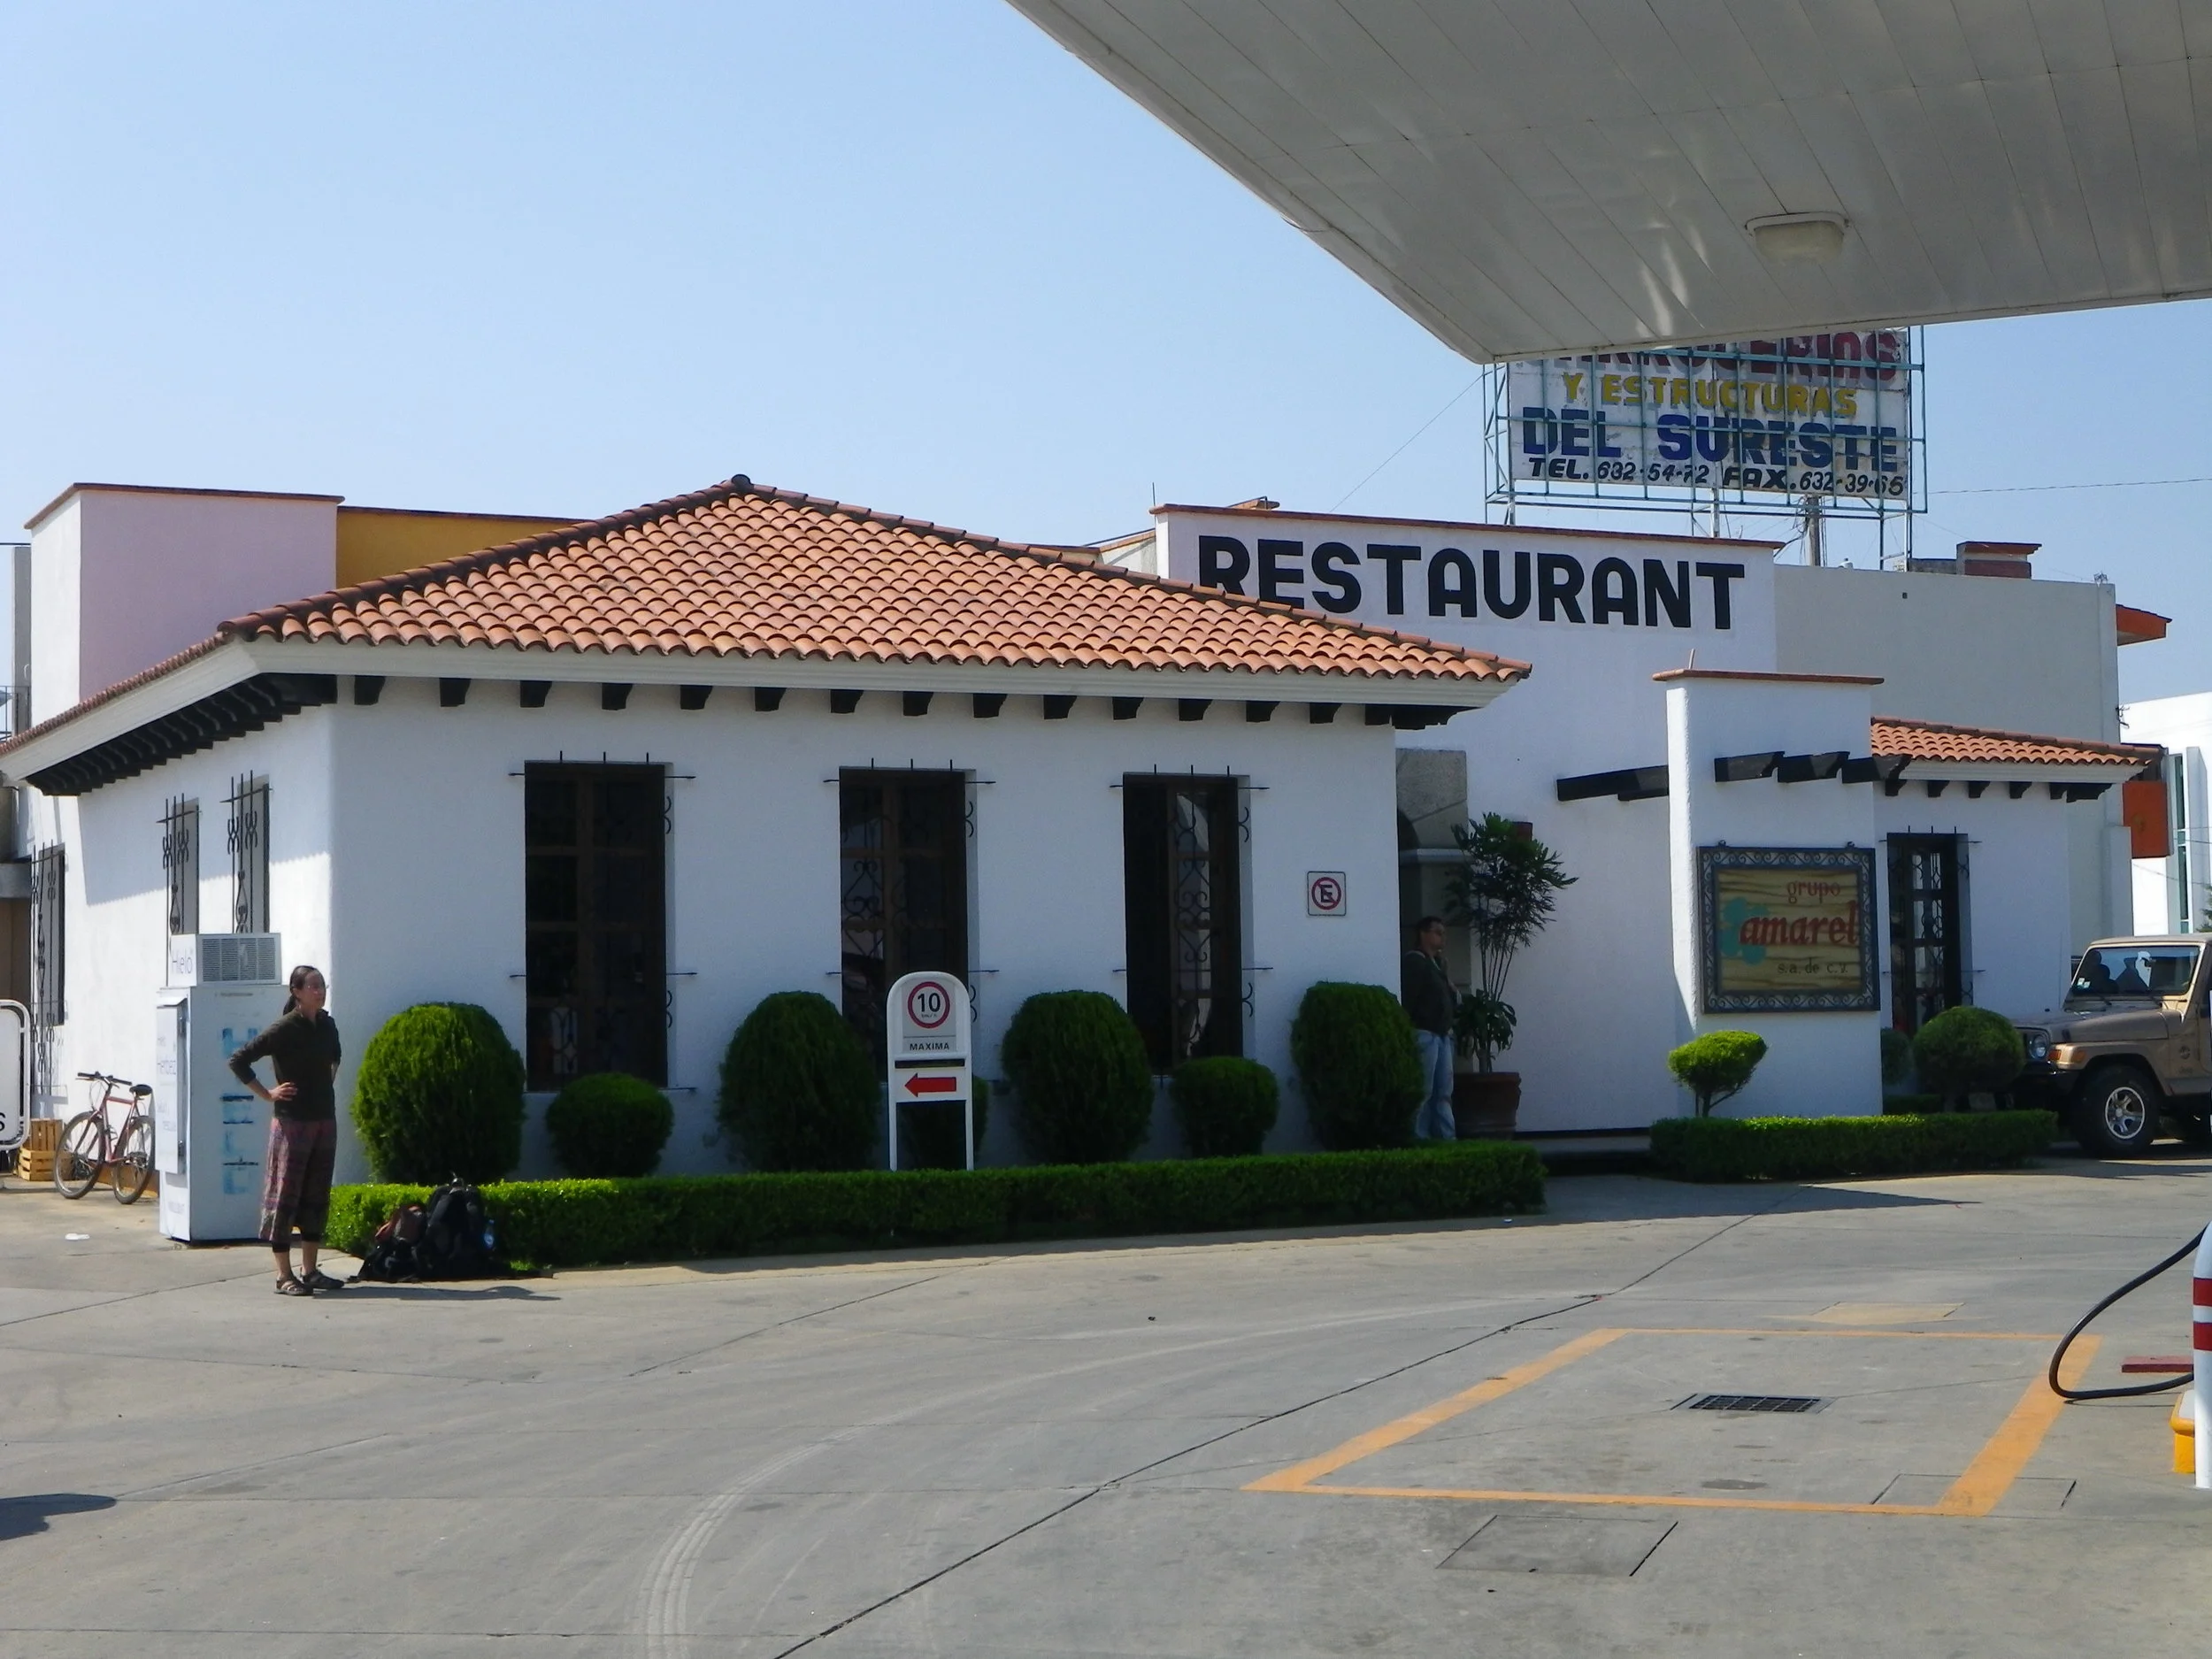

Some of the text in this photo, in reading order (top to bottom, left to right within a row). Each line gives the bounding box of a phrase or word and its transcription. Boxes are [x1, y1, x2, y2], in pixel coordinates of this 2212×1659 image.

[1562, 372, 1857, 417] Y ESTRUCTURAS
[1523, 407, 1899, 472] DEL SURESTE
[1528, 457, 1589, 480] TEL.
[1723, 466, 1797, 490] FAX.
[1199, 535, 1745, 630] RESTAURANT
[1786, 880, 1841, 904] grupo
[1739, 900, 1859, 946] amarel
[1805, 957, 1820, 974] de
[917, 992, 941, 1013] 10
[910, 1042, 950, 1051] MAXIMA
